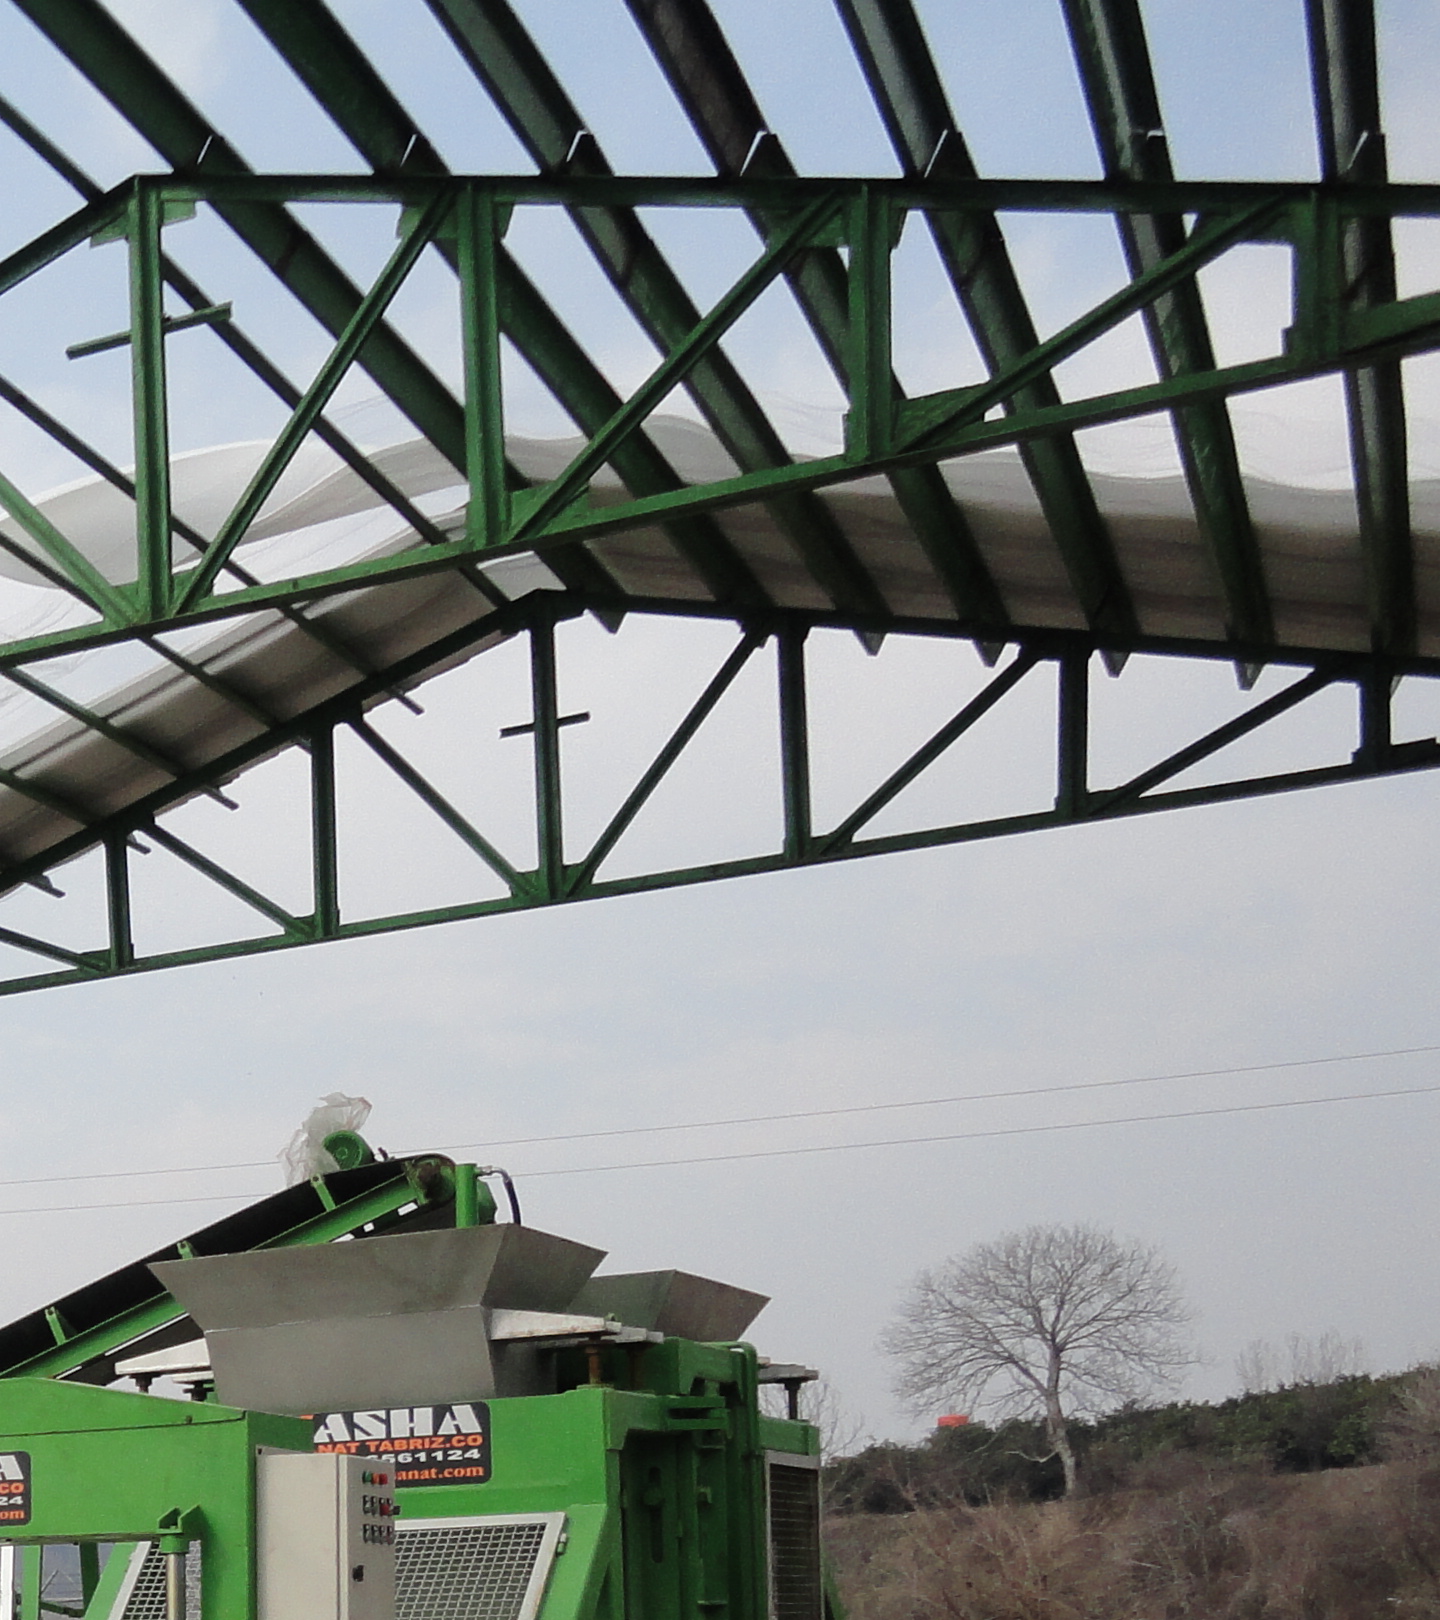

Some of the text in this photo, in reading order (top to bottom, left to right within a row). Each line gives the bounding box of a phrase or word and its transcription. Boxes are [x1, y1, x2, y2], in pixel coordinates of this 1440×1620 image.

[313, 1404, 483, 1443] ASHA
[316, 1434, 483, 1453] NAT TABRIZ.CO
